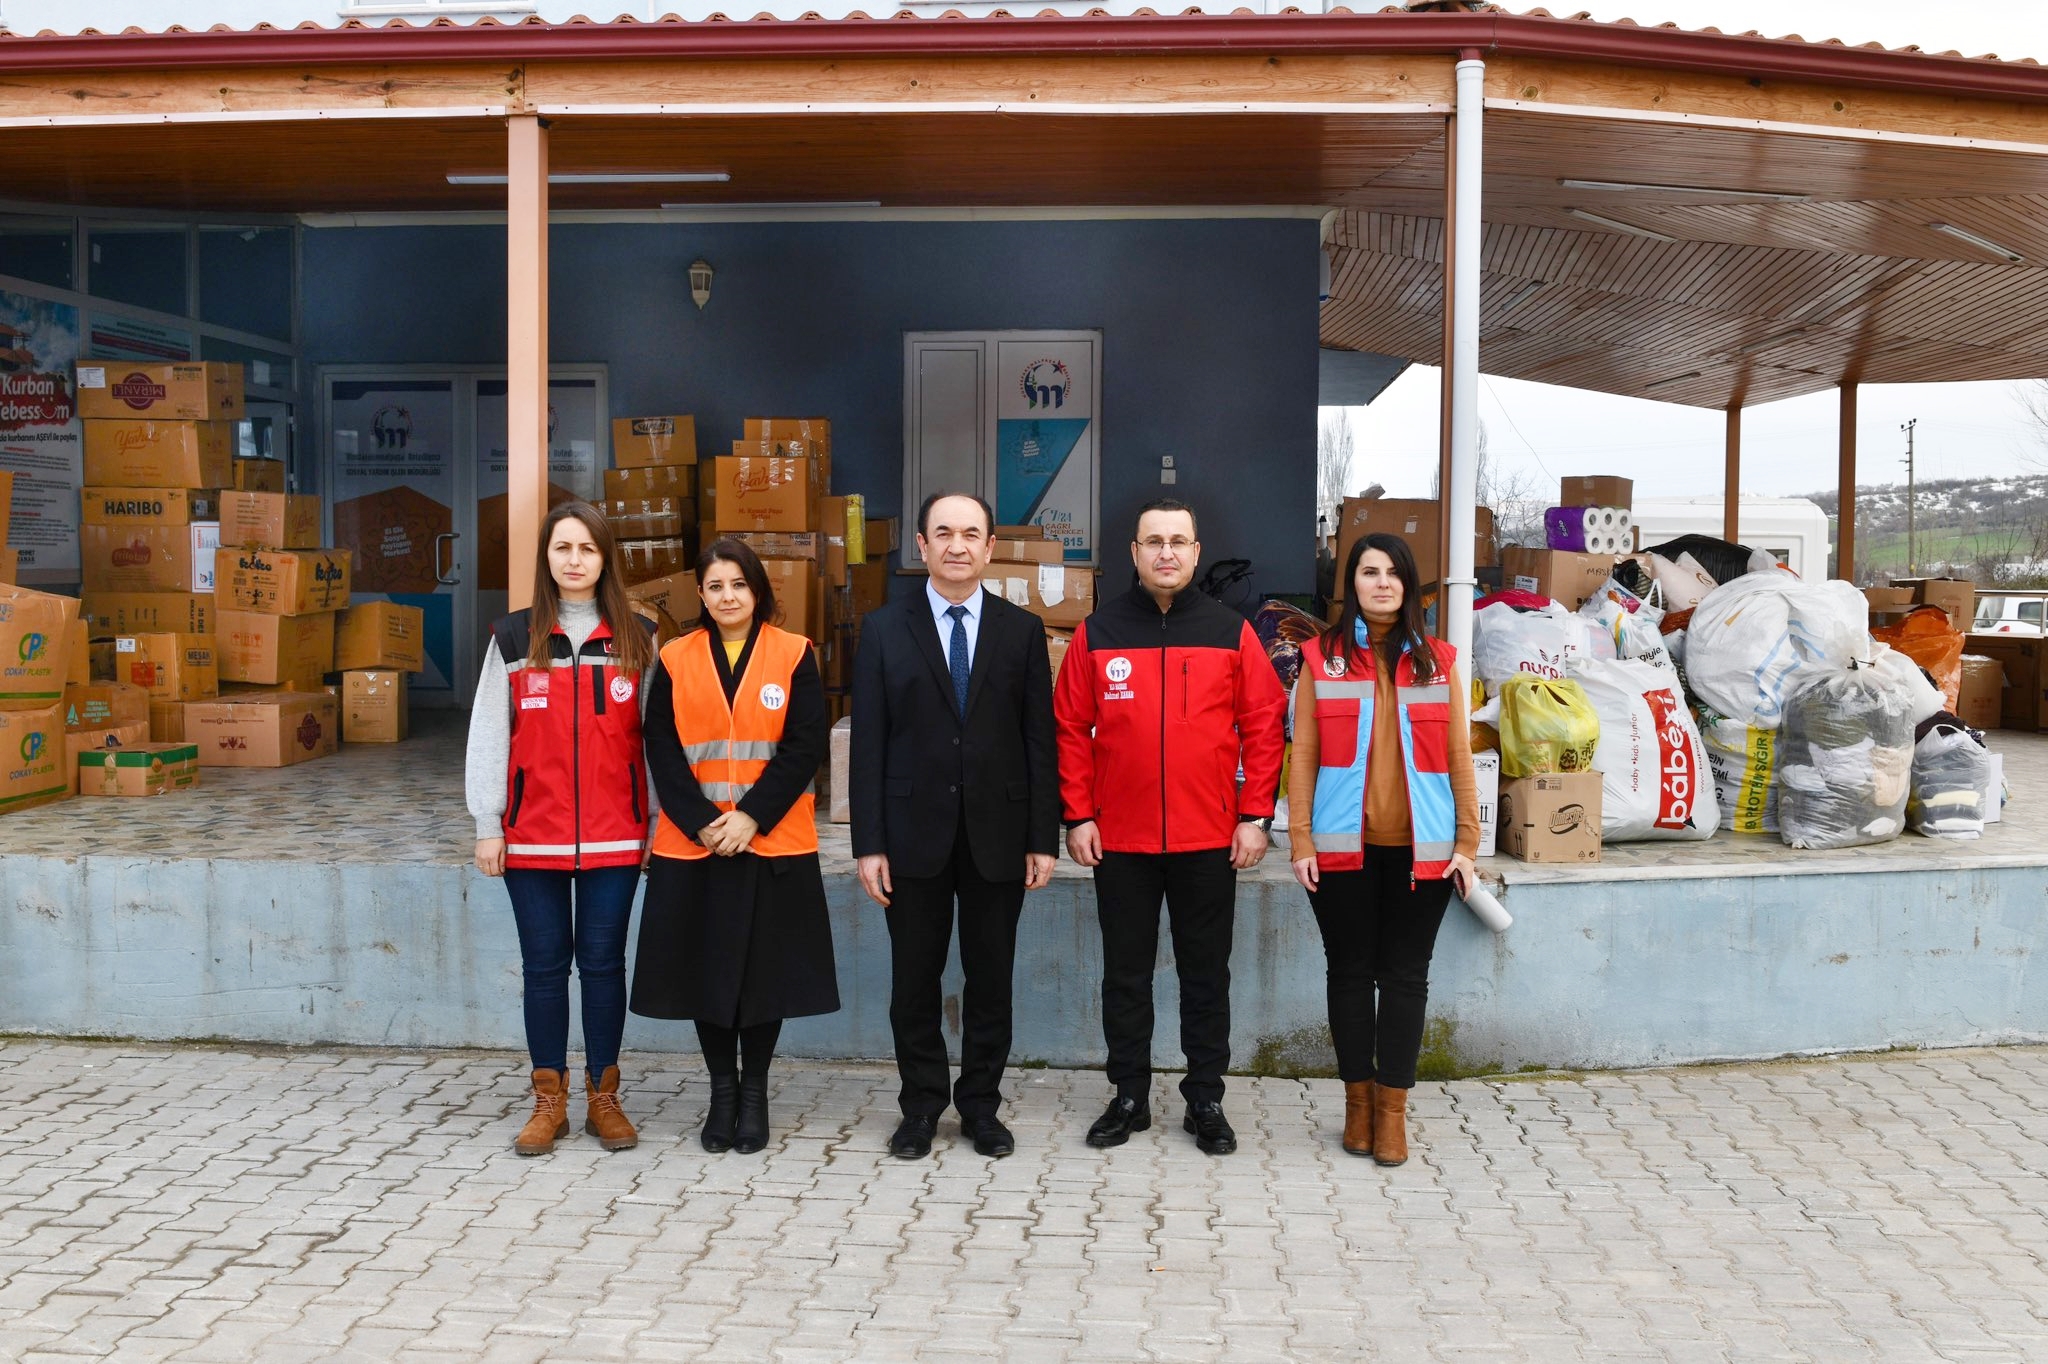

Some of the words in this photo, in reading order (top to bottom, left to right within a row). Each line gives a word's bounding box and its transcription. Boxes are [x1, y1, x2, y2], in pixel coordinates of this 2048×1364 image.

[2, 375, 55, 396] Kurban
[104, 501, 163, 515] HARIBO
[1063, 537, 1084, 547] 815
[1753, 737, 1769, 772] SIĞIR
[1548, 809, 1584, 828] Domestos
